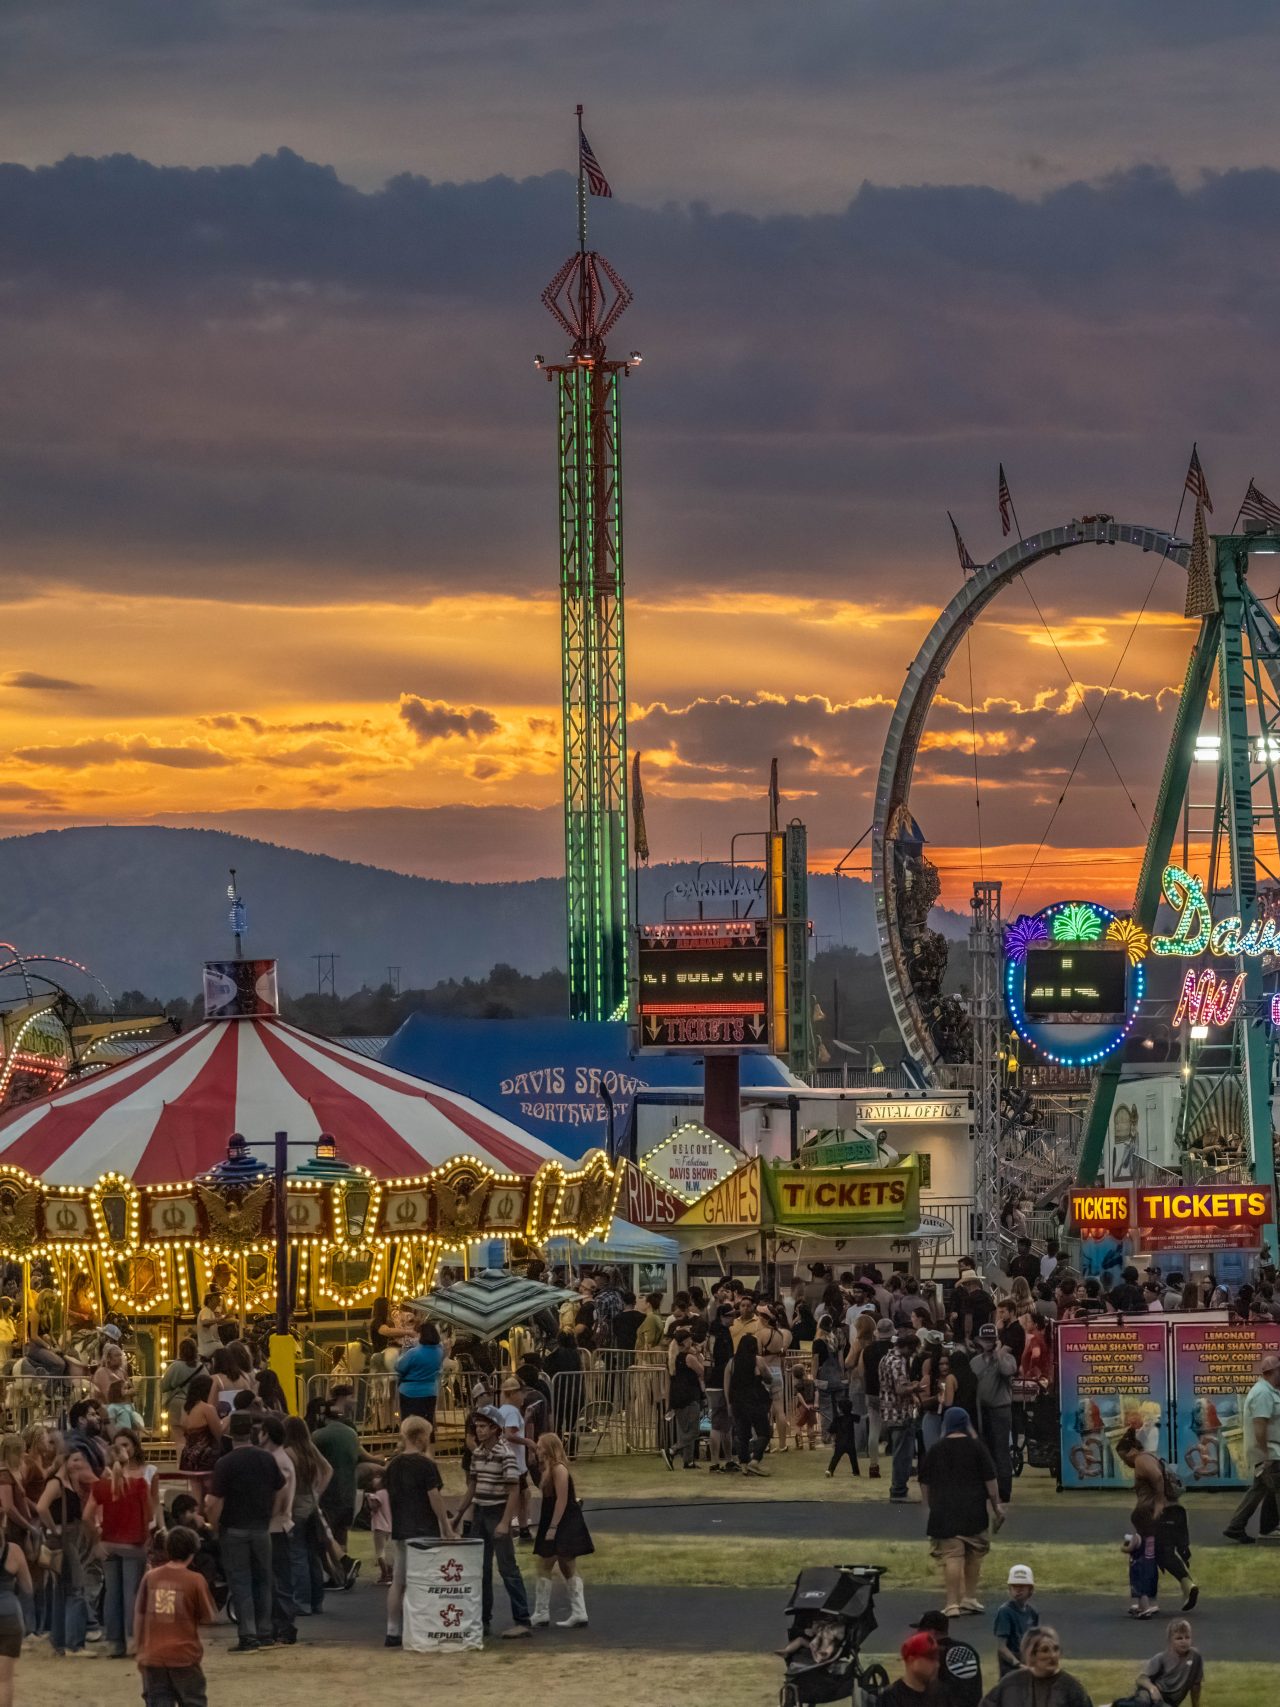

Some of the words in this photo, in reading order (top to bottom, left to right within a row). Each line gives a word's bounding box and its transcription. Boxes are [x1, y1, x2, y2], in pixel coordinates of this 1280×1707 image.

[674, 879, 759, 898] CARNIVAL
[1172, 968, 1248, 1027] NW
[664, 1017, 745, 1043] TICKETS
[500, 1067, 565, 1095] DAVIS
[857, 1104, 911, 1119] ARNIVAL
[915, 1104, 962, 1118] OFFICE
[672, 1144, 713, 1155] WELCOME
[669, 1167, 691, 1181] DAVIS
[692, 1168, 717, 1181] SHOWS
[628, 1166, 675, 1223] RIDES
[703, 1165, 759, 1223] GAMES
[783, 1180, 905, 1207] TICKETS
[1073, 1196, 1128, 1220] TICKETS
[1143, 1193, 1266, 1219] TICKETS
[1088, 1332, 1138, 1341] LEMONADE
[1205, 1332, 1256, 1340] LEMONADE
[1109, 1343, 1145, 1351] SHAVED
[1146, 1342, 1160, 1350] ICE
[1226, 1342, 1263, 1350] SHAVED
[1265, 1342, 1279, 1350] ICE
[1083, 1354, 1112, 1362] SNOW
[1114, 1354, 1143, 1362] CONES
[1199, 1354, 1230, 1362] SNOW
[1092, 1365, 1134, 1373] PRETZELS
[1078, 1376, 1113, 1384] ENERGY
[1115, 1376, 1149, 1384] DRINKS
[1194, 1376, 1230, 1384] ENERGY
[1232, 1375, 1259, 1383] DRIN
[1078, 1387, 1116, 1395] BOTTLED
[1118, 1386, 1150, 1394] WATER
[1194, 1387, 1233, 1395] BOTTLED
[428, 1586, 472, 1594] REPUBLIC
[427, 1631, 472, 1639] REPUBLIC
